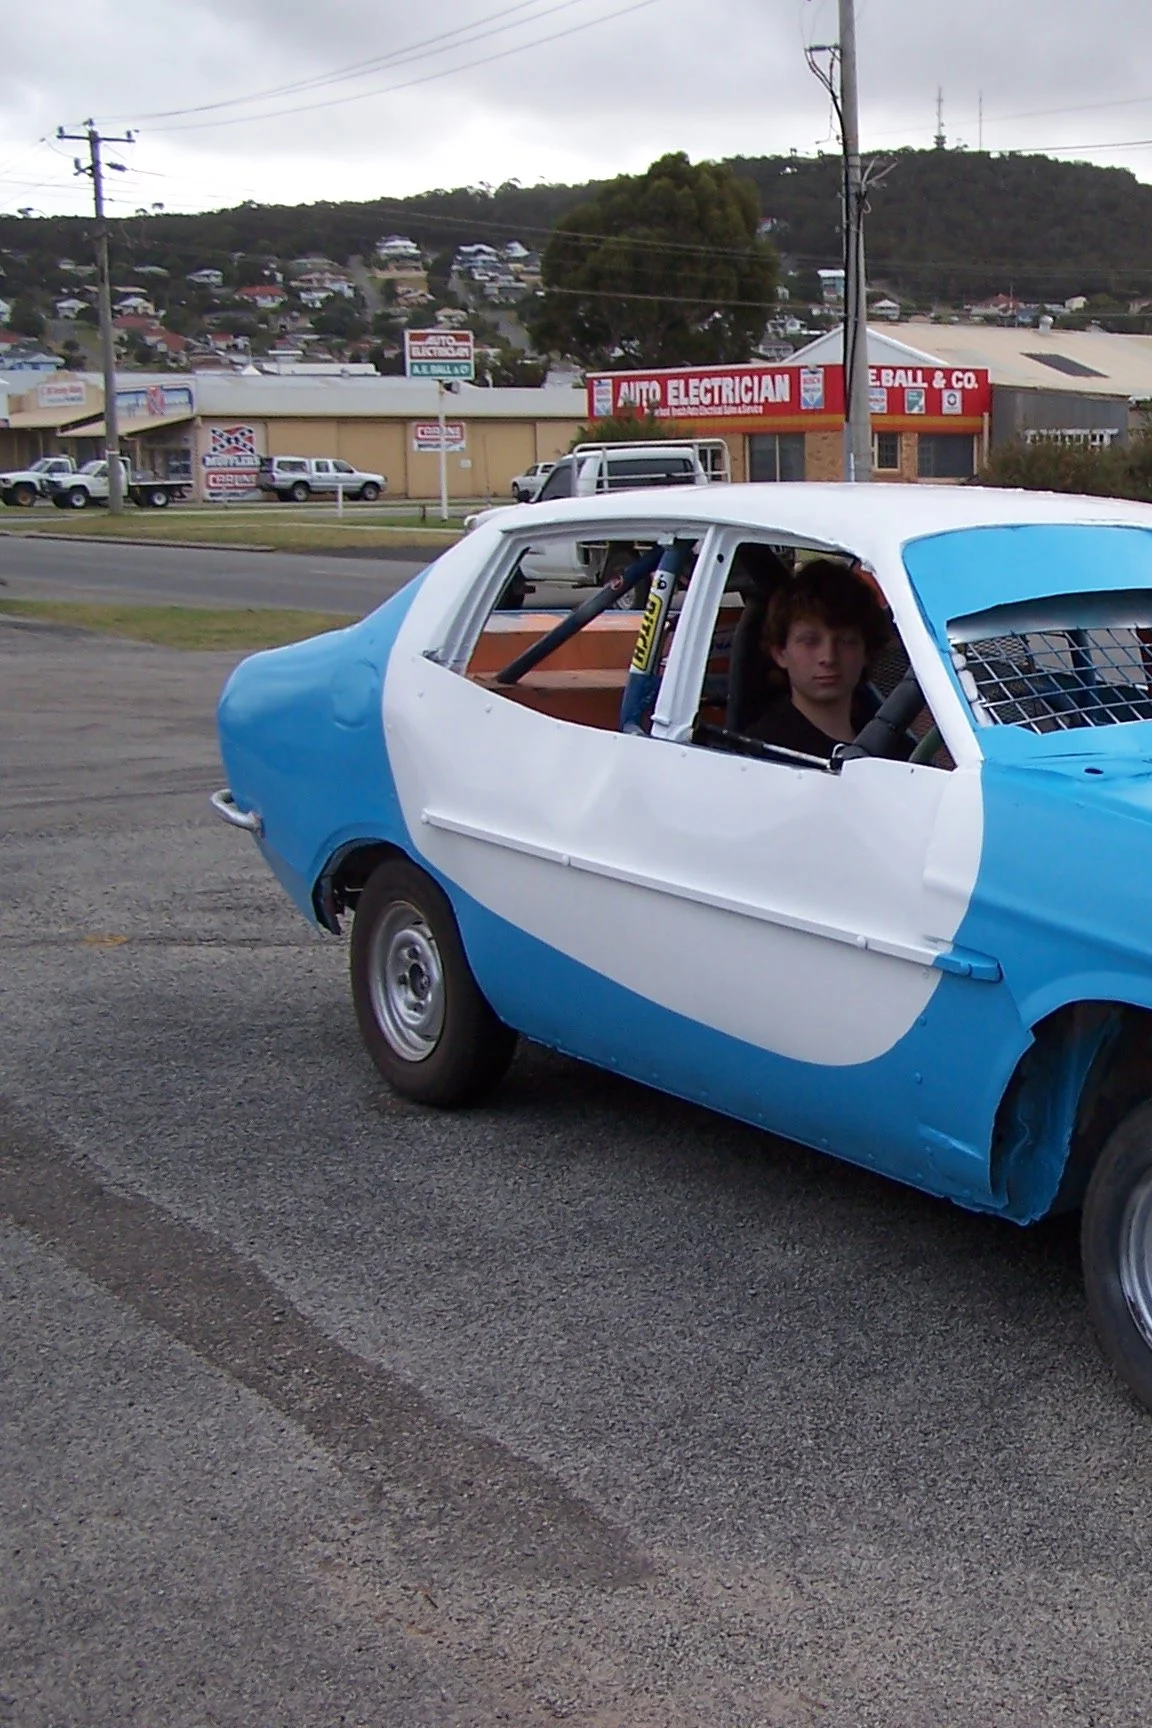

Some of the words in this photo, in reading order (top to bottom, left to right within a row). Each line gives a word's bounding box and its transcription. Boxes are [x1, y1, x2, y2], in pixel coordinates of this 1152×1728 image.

[617, 380, 661, 408] AUTO
[667, 374, 790, 405] ELECTRICIAN
[932, 370, 946, 389] &
[951, 370, 979, 389] CO.
